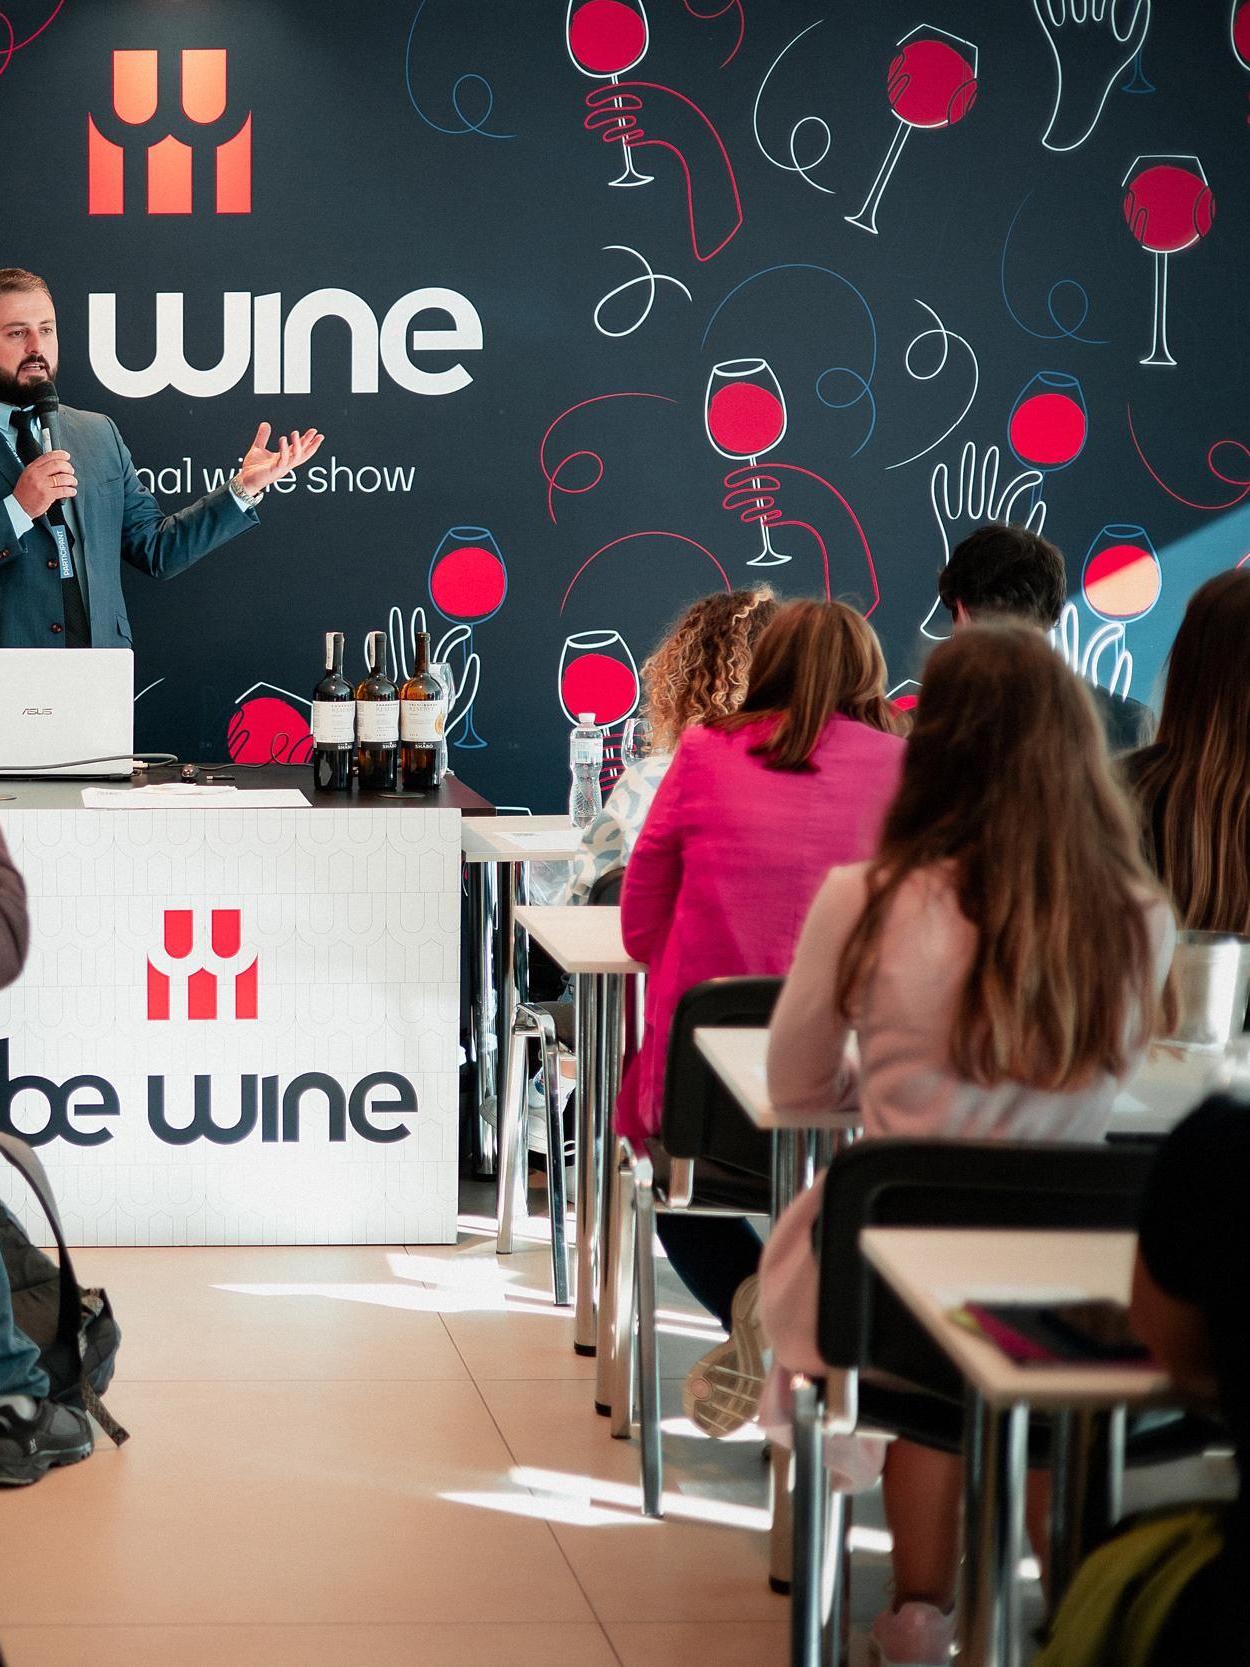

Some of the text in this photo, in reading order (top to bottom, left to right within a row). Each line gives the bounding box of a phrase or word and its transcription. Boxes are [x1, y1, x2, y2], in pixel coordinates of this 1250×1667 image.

[89, 287, 484, 399] wine
[306, 456, 416, 494] show
[57, 530, 70, 577] PARTICIPANT
[147, 1071, 418, 1145] wine
